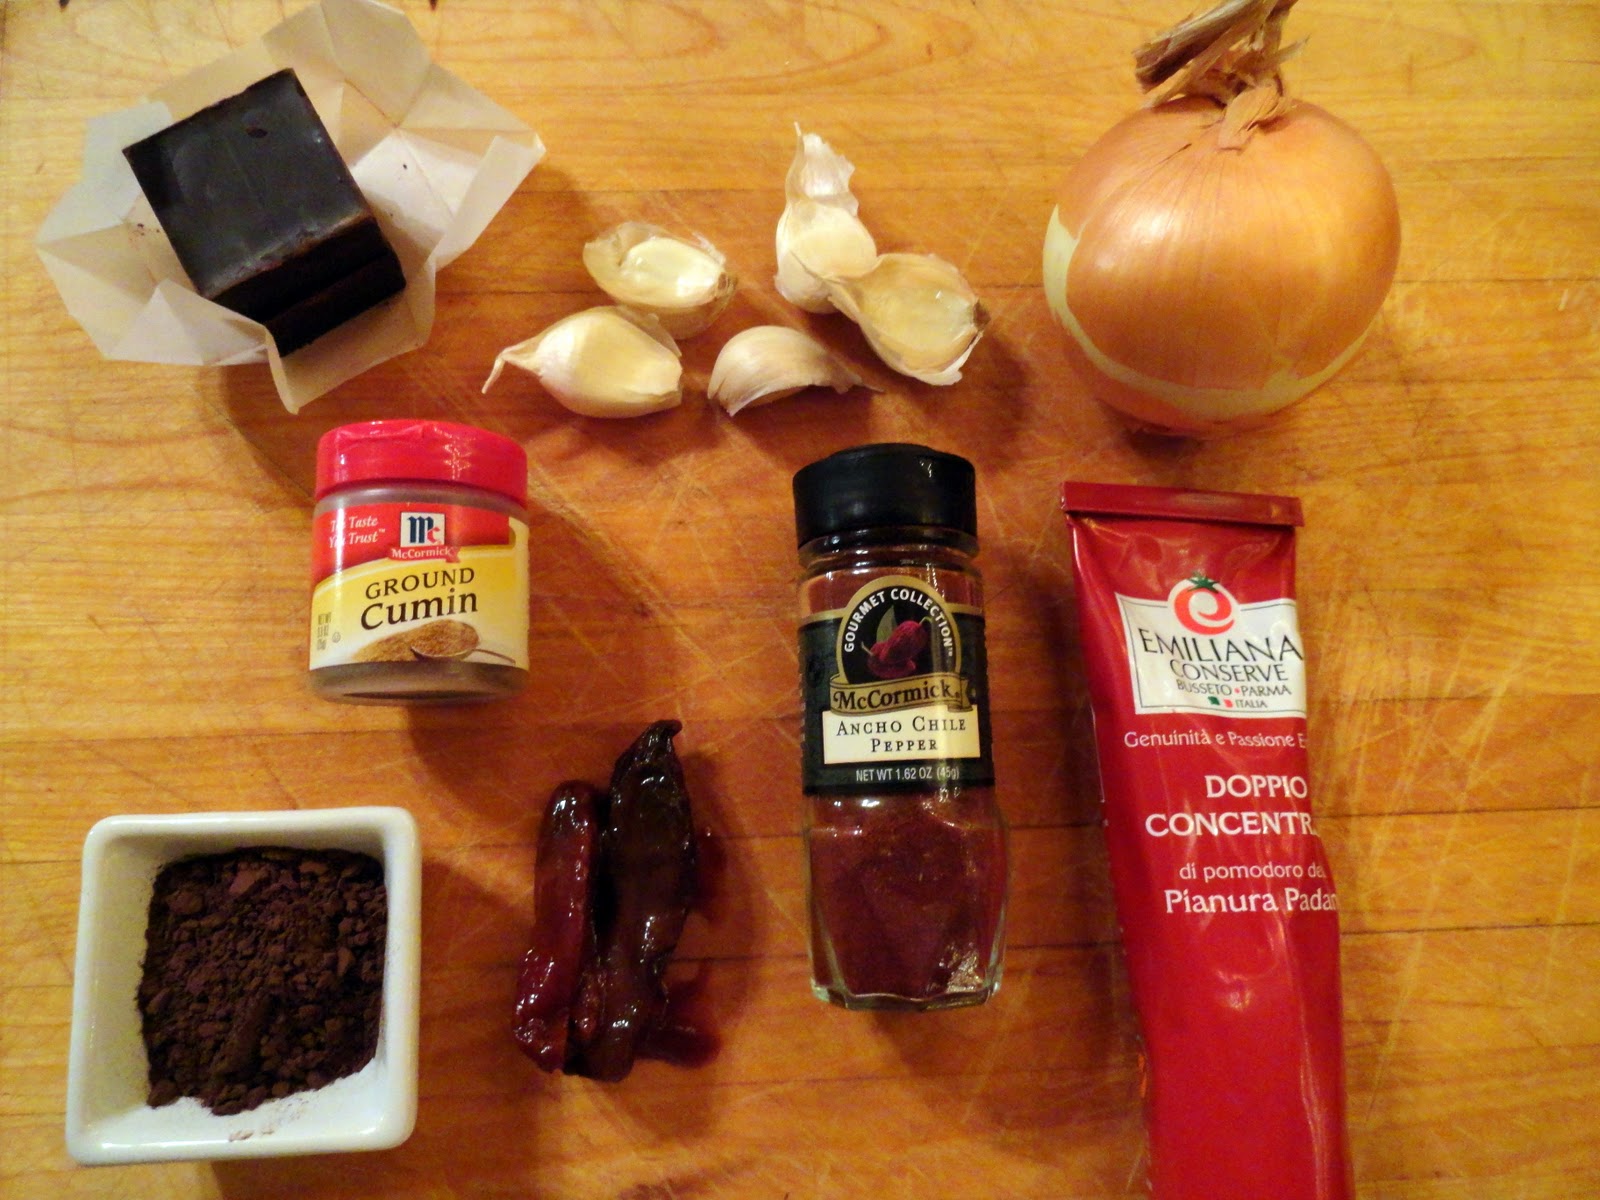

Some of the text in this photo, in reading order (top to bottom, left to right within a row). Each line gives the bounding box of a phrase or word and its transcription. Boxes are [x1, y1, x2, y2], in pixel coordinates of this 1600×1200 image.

[349, 515, 378, 528] Taste
[391, 547, 451, 559] McCormick
[365, 567, 475, 599] GROUND
[361, 587, 478, 630] Cumin
[844, 591, 886, 652] GOURMET
[1138, 628, 1303, 662] EMILIANA
[1169, 659, 1288, 682] CONSERVE
[833, 680, 958, 710] McCormick
[1176, 679, 1291, 696] BUSSETO PARMA
[1235, 699, 1268, 709] ITALIA
[836, 716, 966, 736] ANCHO CHILE
[871, 738, 938, 752] PEPPER
[1124, 728, 1211, 747] Genuinità
[1215, 733, 1225, 744] e
[1227, 731, 1295, 747] Passione
[856, 769, 874, 782] NET
[876, 768, 893, 780] WT
[895, 767, 917, 780] 1.62
[919, 766, 933, 779] OZ
[1204, 775, 1308, 799] DOPPIO
[1145, 811, 1317, 837] CONCENTR
[1179, 862, 1197, 880] di
[1203, 862, 1304, 883] pomodoro
[1164, 889, 1279, 914] Pianura
